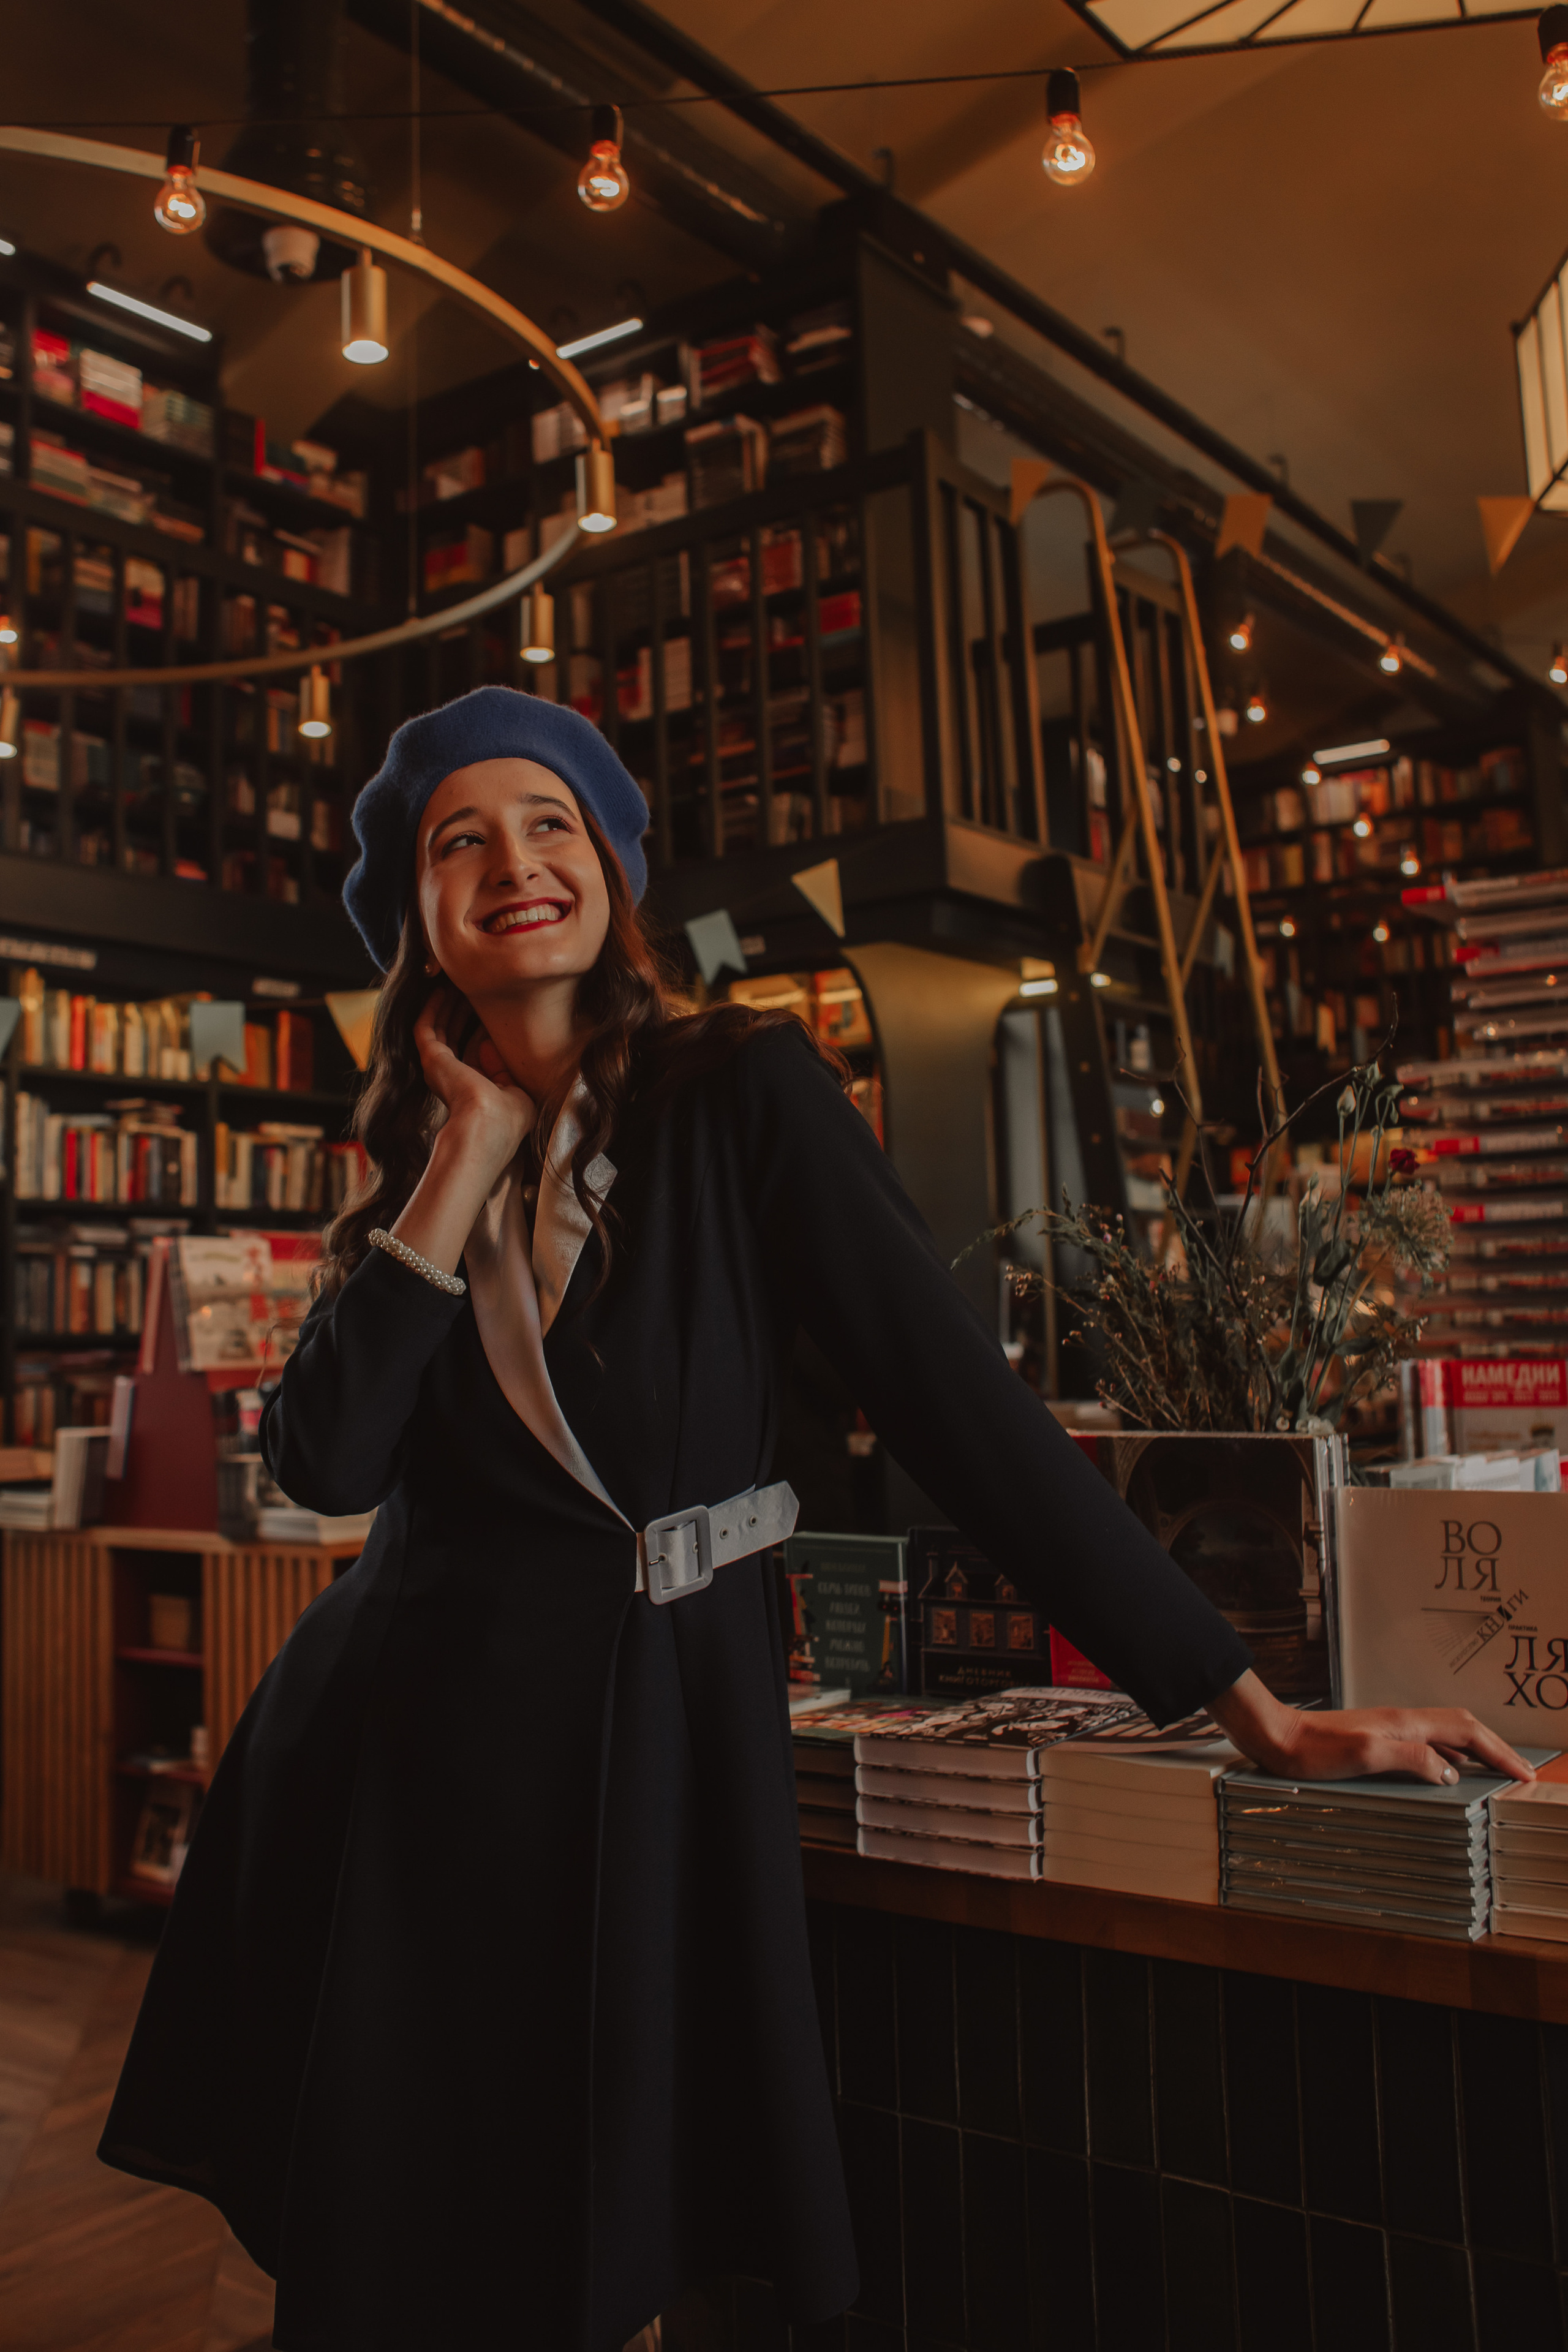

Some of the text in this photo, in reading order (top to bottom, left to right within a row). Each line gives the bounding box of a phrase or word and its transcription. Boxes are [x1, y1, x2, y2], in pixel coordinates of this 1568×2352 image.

[1461, 1362, 1561, 1391] НАМЕДНИ
[1441, 1519, 1502, 1556] ВО
[1434, 1555, 1501, 1592] ЛЯ
[957, 1666, 1011, 1678] ДНЕВНИК
